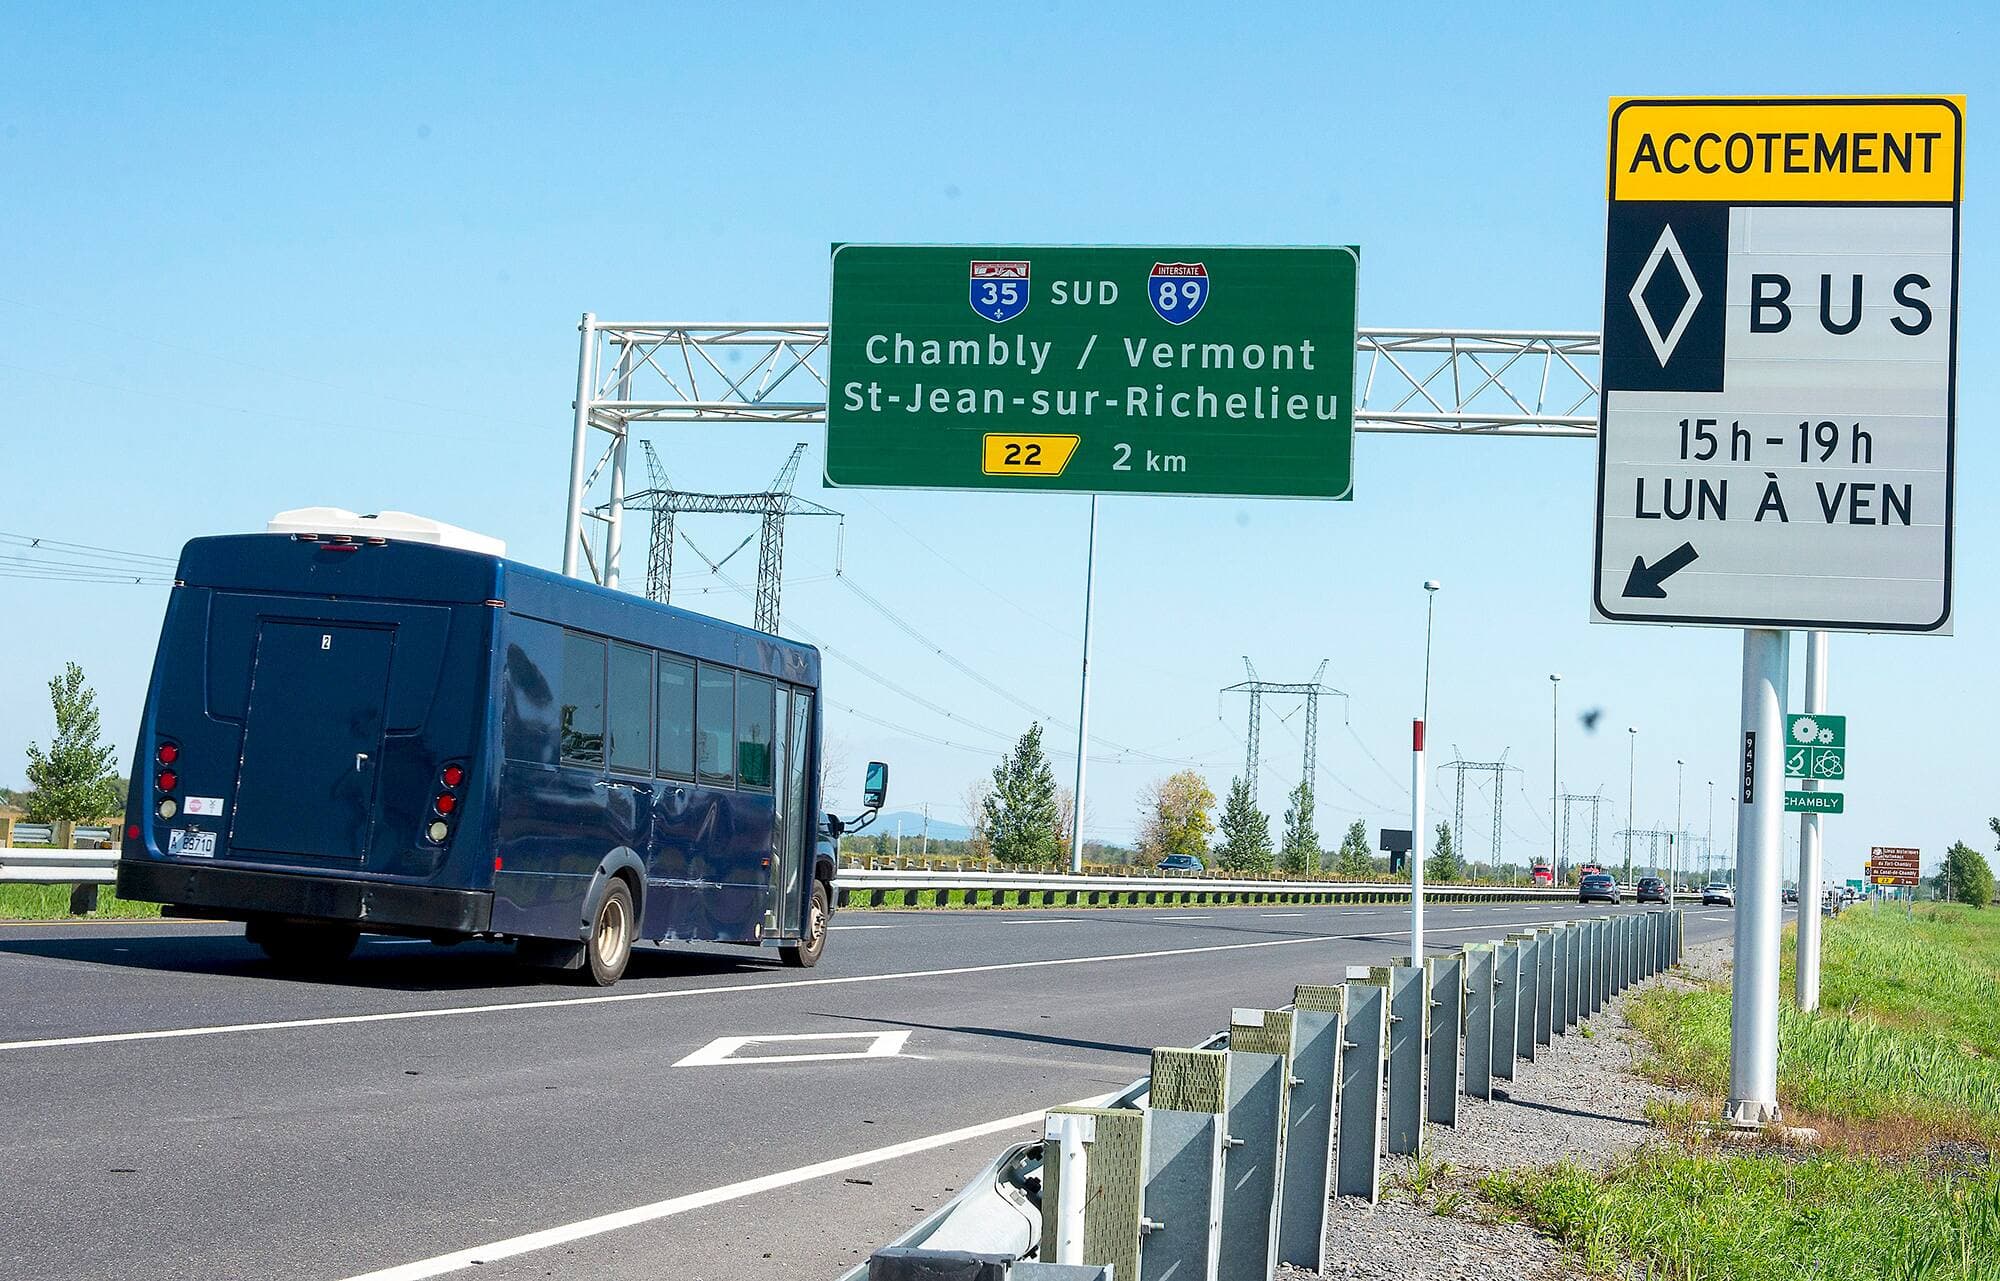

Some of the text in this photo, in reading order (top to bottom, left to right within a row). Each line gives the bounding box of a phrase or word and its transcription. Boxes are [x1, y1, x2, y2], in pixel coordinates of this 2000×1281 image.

[1629, 132, 1941, 174] ACCOTEMENT
[1158, 266, 1200, 276] INTERSTATE
[981, 280, 1200, 310] 35 SUD 89
[1749, 272, 1932, 336] BUS
[865, 333, 1316, 374] Chambly / Vermont
[843, 382, 1338, 421] St-Jean-sur-Richelieu
[1004, 443, 1187, 473] 22 2 km
[1636, 472, 1911, 526] LUN À VEN
[324, 637, 330, 648] 2
[1745, 738, 1753, 799] 94509
[1784, 797, 1839, 808] CHAMBLY
